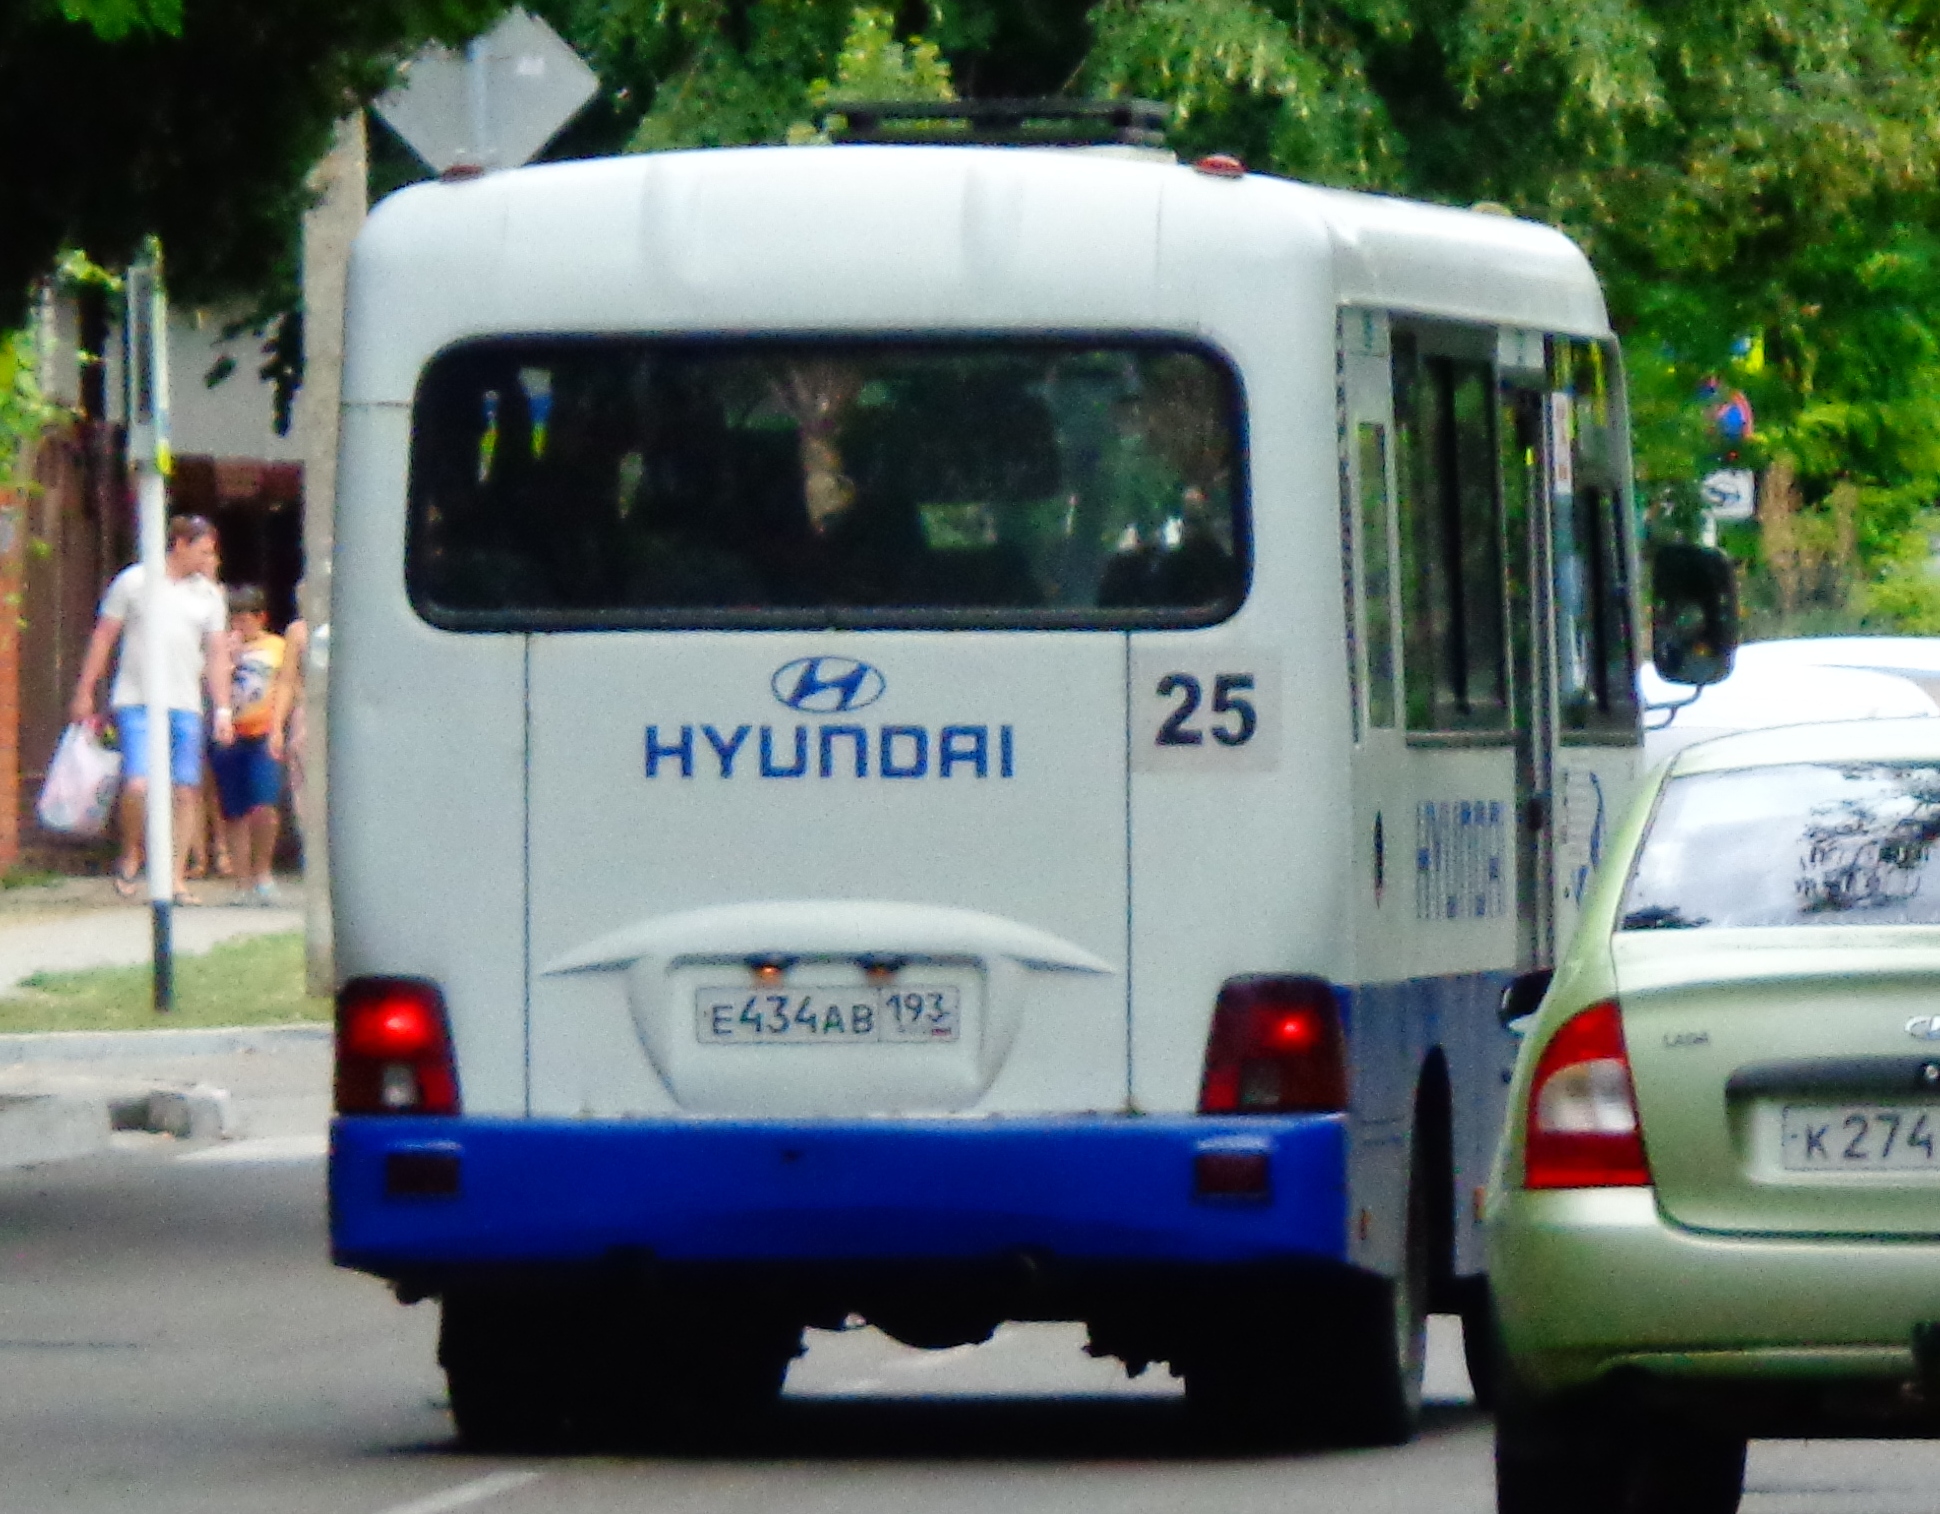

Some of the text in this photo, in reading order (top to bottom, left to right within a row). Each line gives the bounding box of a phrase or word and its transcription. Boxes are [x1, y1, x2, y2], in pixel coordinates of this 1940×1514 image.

[1155, 672, 1257, 747] 25
[644, 724, 1014, 779] HYUNDAI
[710, 996, 874, 1035] E434AB
